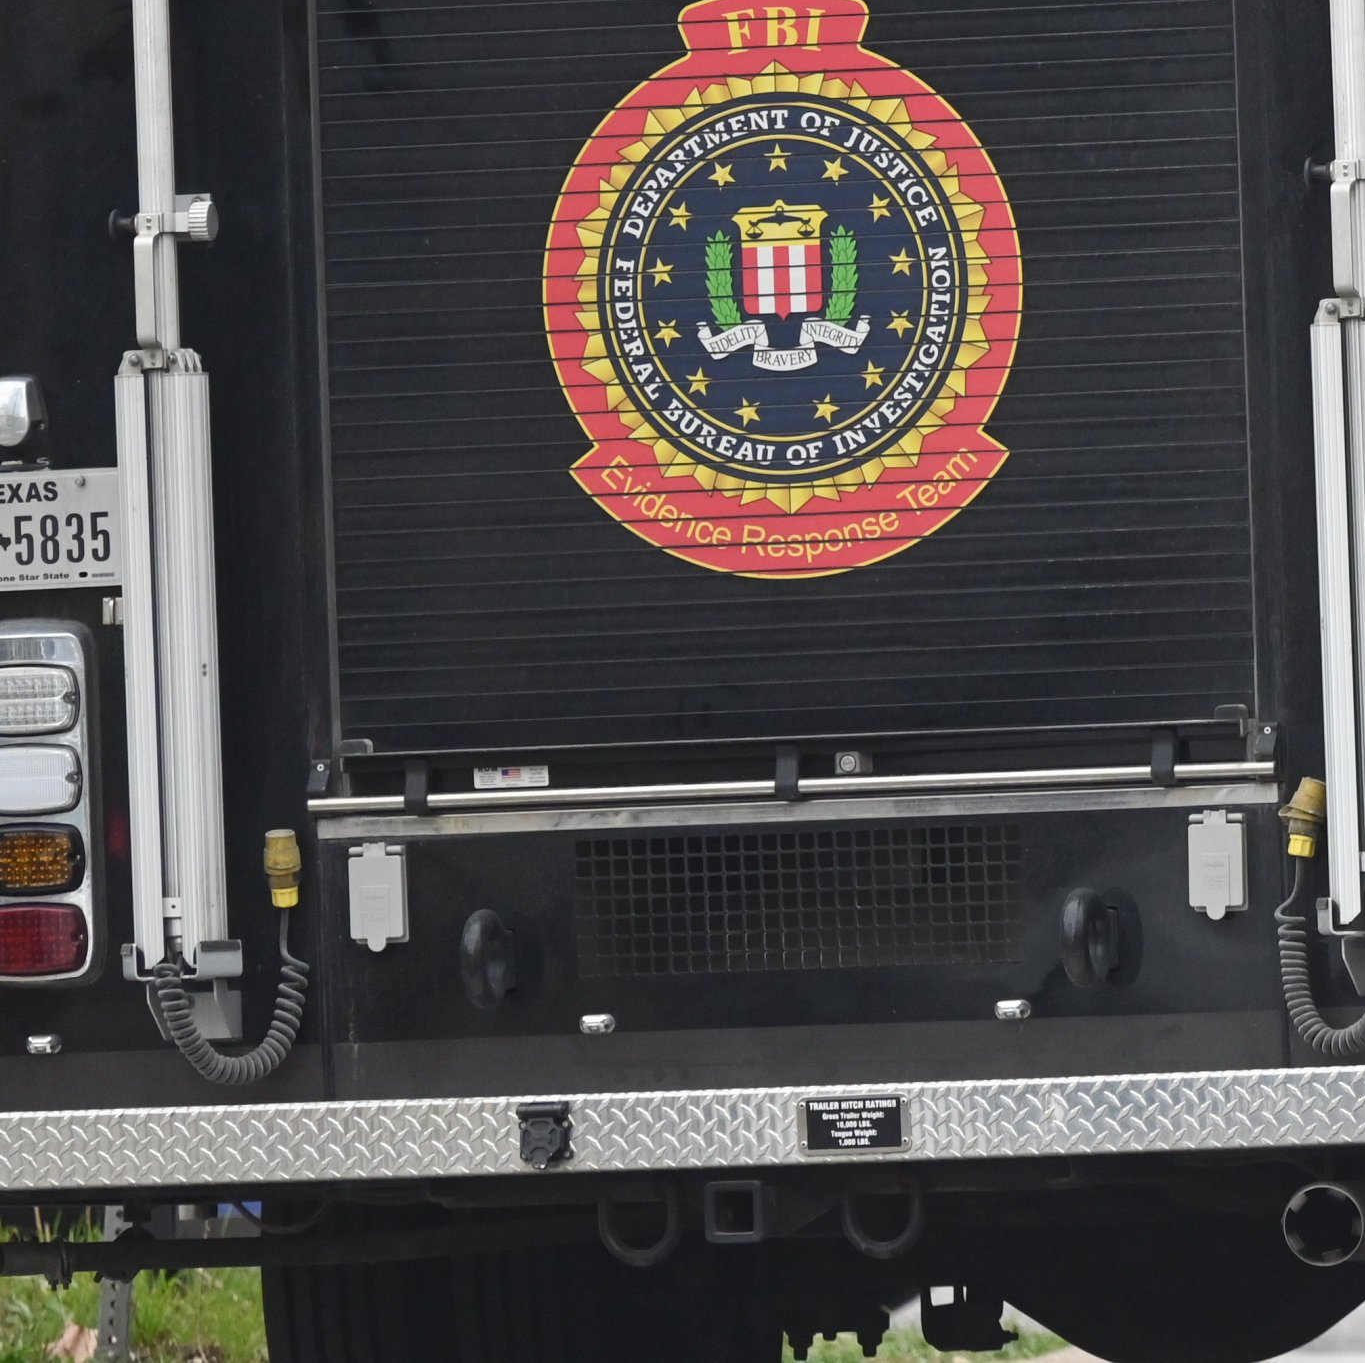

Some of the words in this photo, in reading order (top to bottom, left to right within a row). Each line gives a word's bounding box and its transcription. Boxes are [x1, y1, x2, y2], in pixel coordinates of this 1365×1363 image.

[722, 6, 826, 55] FBI
[622, 110, 789, 239] DEPARTMENT
[800, 112, 840, 137] OF
[844, 126, 939, 228] JUSTICE
[709, 325, 760, 354] FIDELITY
[806, 323, 863, 349] INTEGRITY
[614, 257, 660, 400] FEDERAL
[665, 398, 776, 467] BUREAU
[786, 441, 823, 466] OF
[836, 245, 952, 454] INVESTIGATION
[755, 349, 814, 367] BRAVERY
[600, 454, 733, 550] Evidence
[741, 509, 899, 563] Response
[896, 447, 978, 517] Team
[19, 573, 40, 581] Star
[43, 572, 70, 580] State
[809, 1101, 839, 1111] TRAILER
[841, 1100, 863, 1109] HITCH
[865, 1099, 897, 1109] RATINGS
[861, 1111, 885, 1120] Weight:
[831, 1130, 852, 1138] Tongue
[854, 1129, 877, 1138] Weight:
